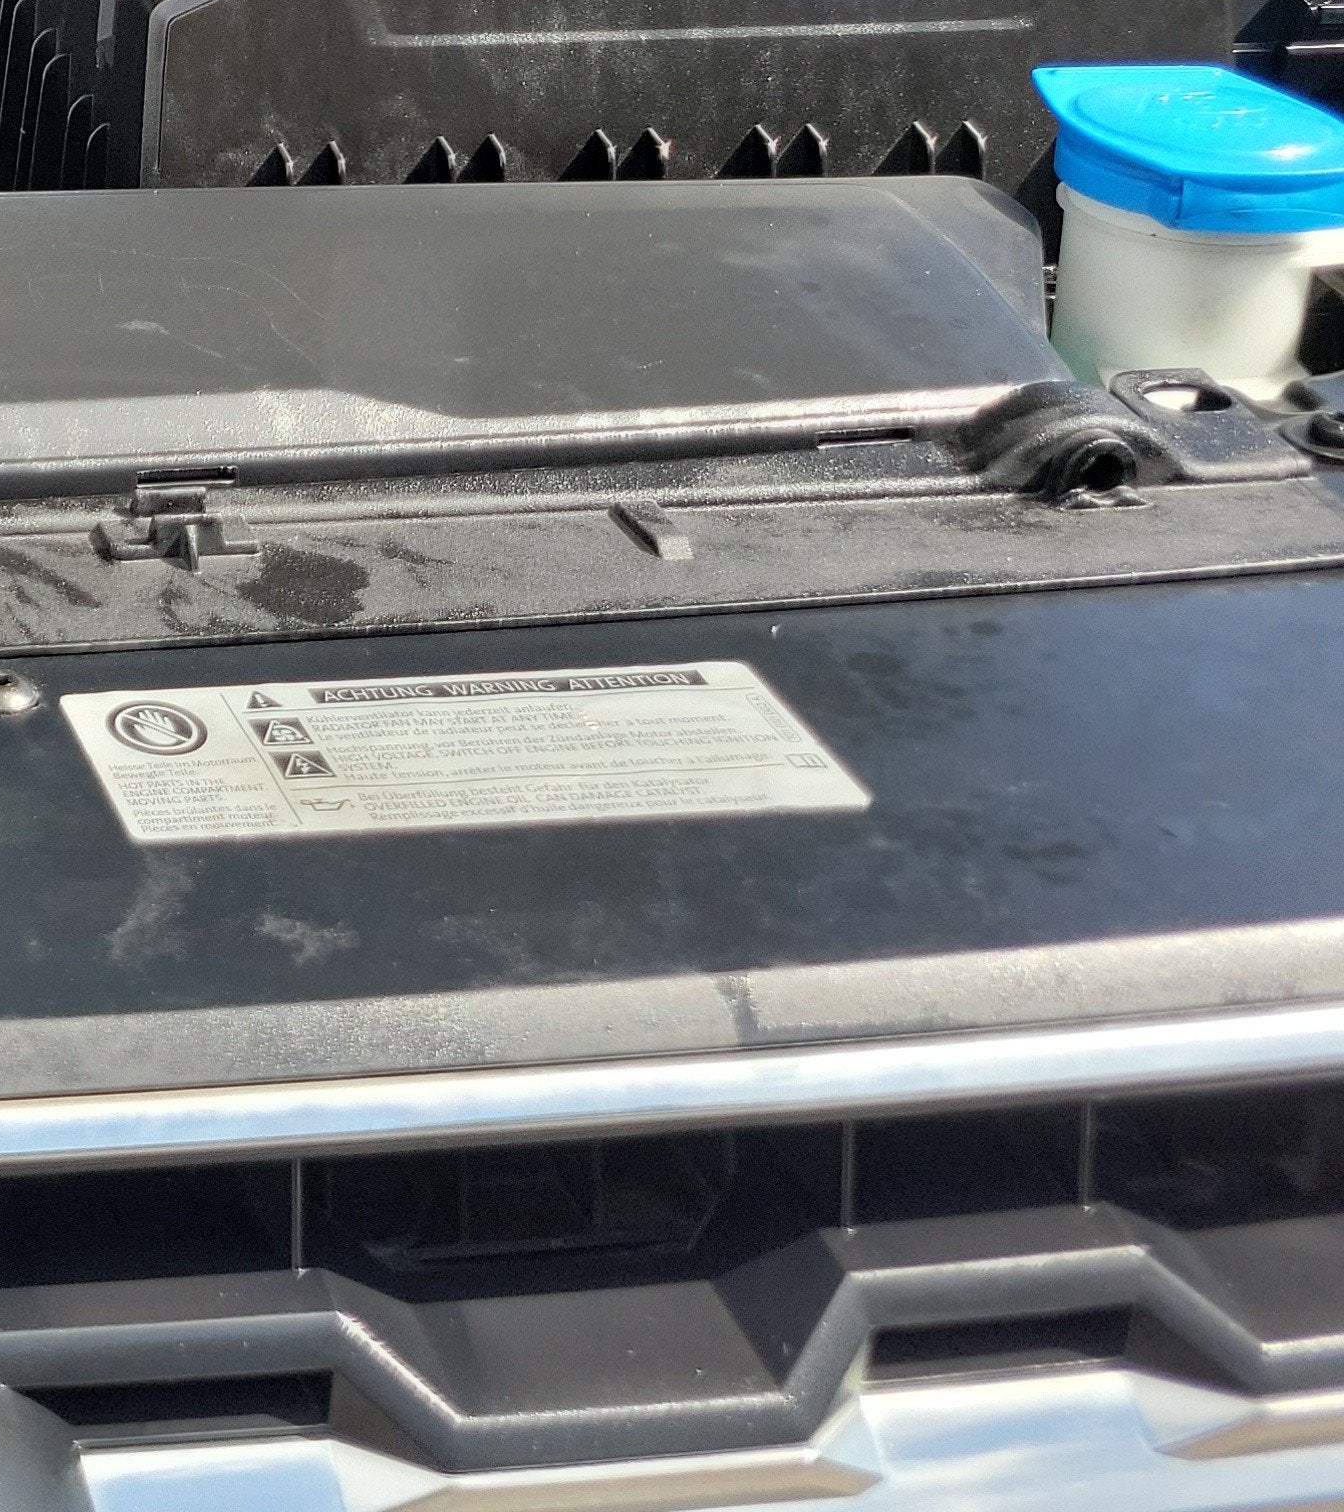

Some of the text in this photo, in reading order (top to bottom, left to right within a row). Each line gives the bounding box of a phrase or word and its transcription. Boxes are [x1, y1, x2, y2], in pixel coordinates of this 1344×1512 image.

[318, 671, 693, 701] ACHTUNG WARNING ATTENTION
[411, 716, 446, 726] MAY
